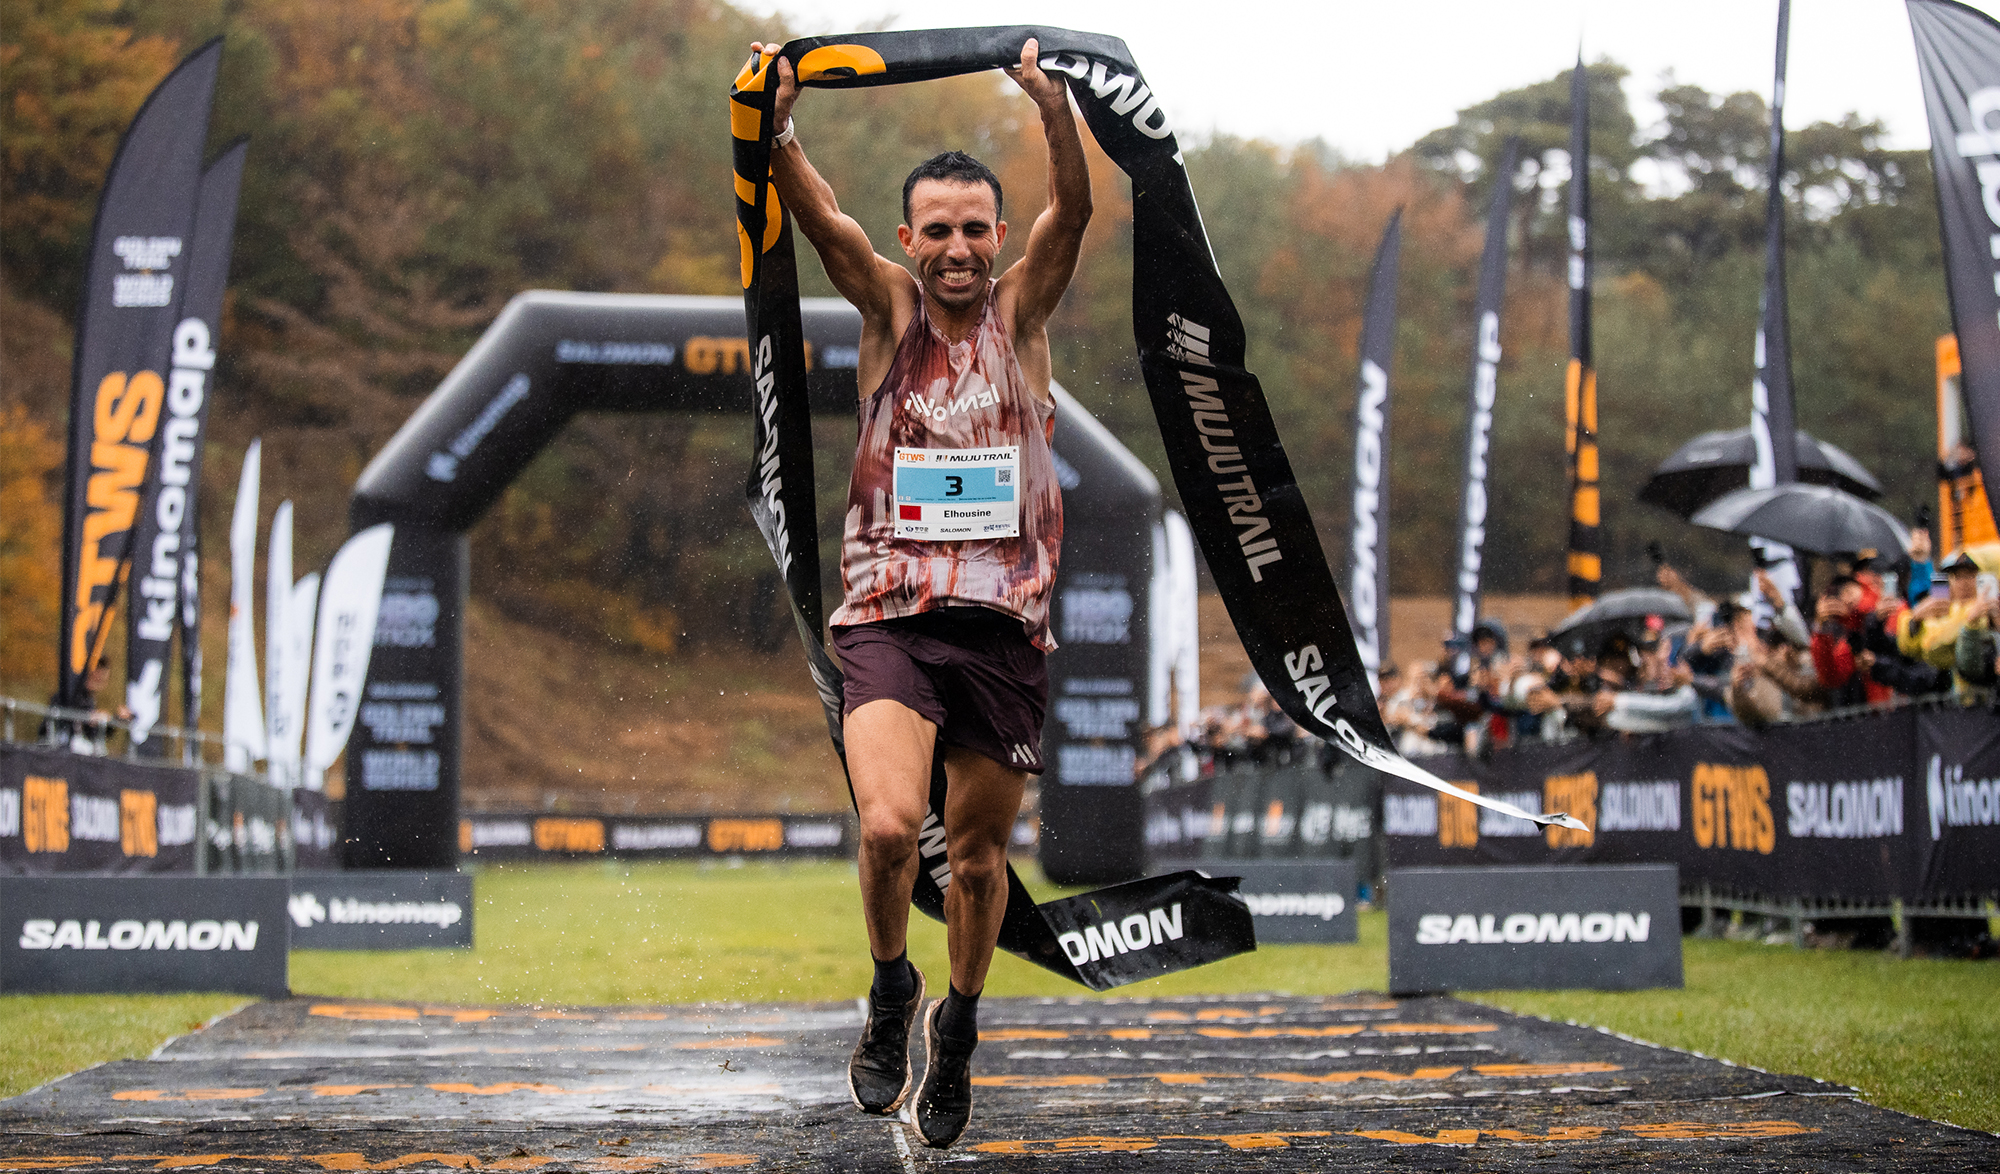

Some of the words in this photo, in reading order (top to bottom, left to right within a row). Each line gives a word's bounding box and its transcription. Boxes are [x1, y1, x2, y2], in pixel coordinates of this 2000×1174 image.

[899, 453, 925, 462] GTWS
[983, 453, 1013, 461] TRAIL
[138, 316, 217, 642] kinomap
[945, 476, 963, 496] 3
[1179, 370, 1249, 475] MUJU
[1217, 475, 1283, 583] TRAIL
[944, 509, 992, 518] Elhousine
[1284, 644, 1367, 752] SALO
[1691, 762, 1776, 855] GTWS
[1786, 776, 1904, 839] SALOMON
[1945, 763, 2000, 827] kino
[330, 898, 462, 929] kinomap
[1247, 893, 1346, 921] nomap
[18, 918, 260, 951] SALOMON
[1058, 903, 1183, 966] OMON
[1416, 911, 1652, 945] SALOMON
